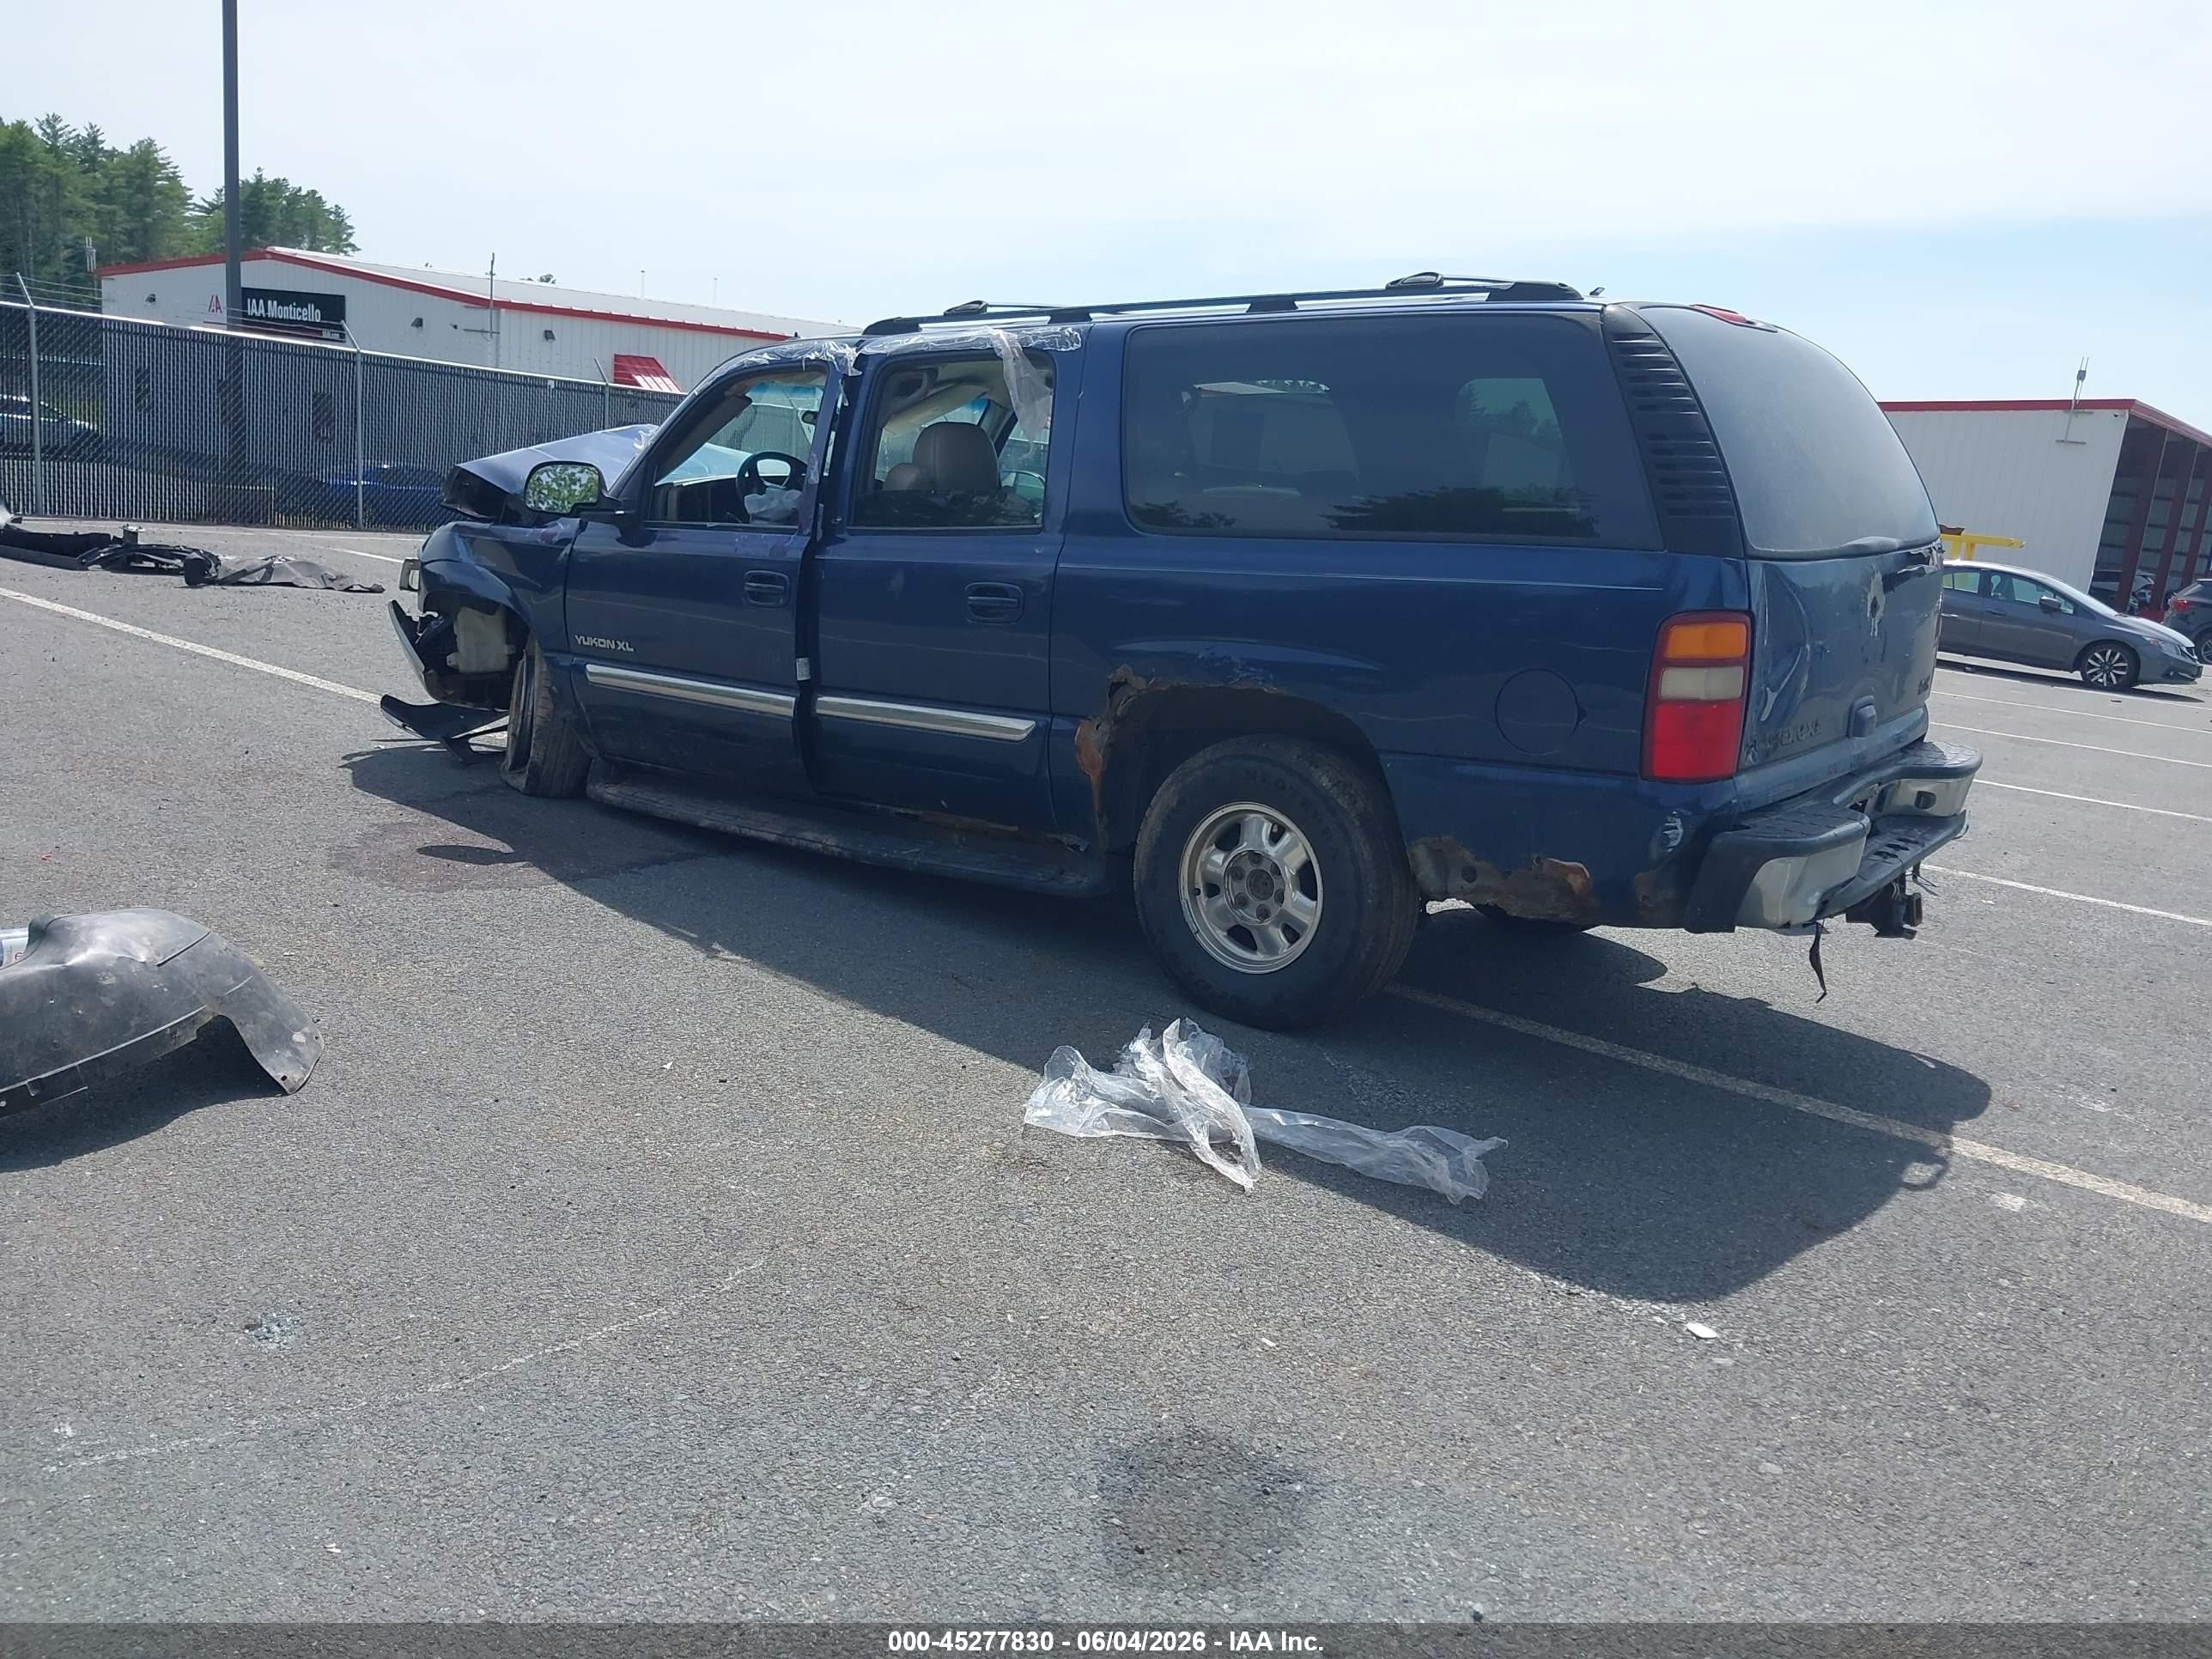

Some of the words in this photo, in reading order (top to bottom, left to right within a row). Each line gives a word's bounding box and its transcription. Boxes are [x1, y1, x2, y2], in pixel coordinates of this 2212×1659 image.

[247, 297, 265, 317] IAA
[267, 300, 321, 323] Monticello
[574, 635, 616, 650] YUKON
[617, 641, 635, 653] XL
